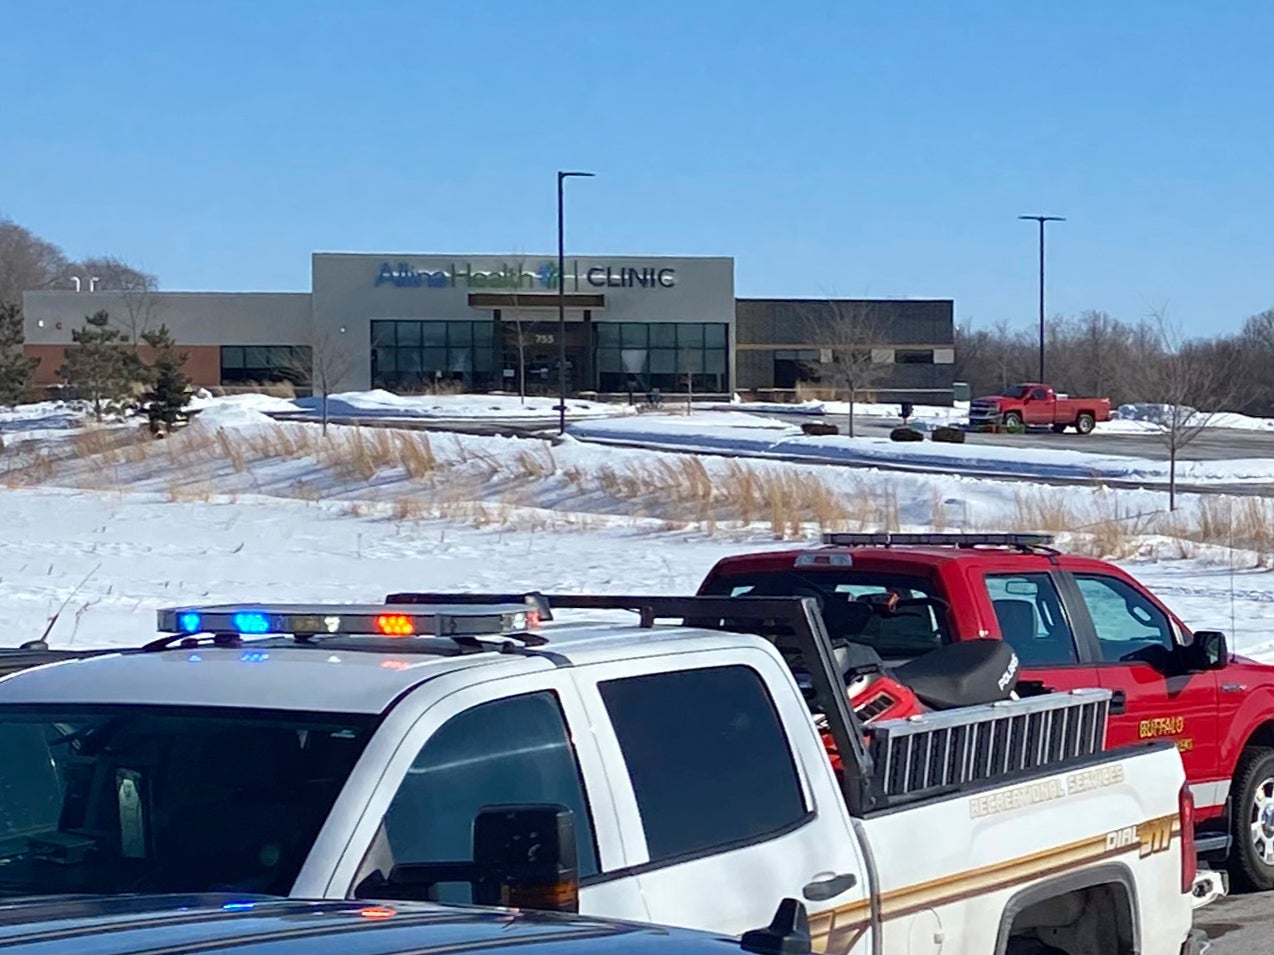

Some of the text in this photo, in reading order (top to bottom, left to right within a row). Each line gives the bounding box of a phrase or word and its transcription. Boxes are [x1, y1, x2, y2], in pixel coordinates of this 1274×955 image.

[586, 266, 677, 289] CLINIC
[1139, 716, 1184, 739] BUFFALO
[968, 763, 1125, 820] RECREATIONAL SERVICES
[1105, 824, 1139, 852] DIAL
